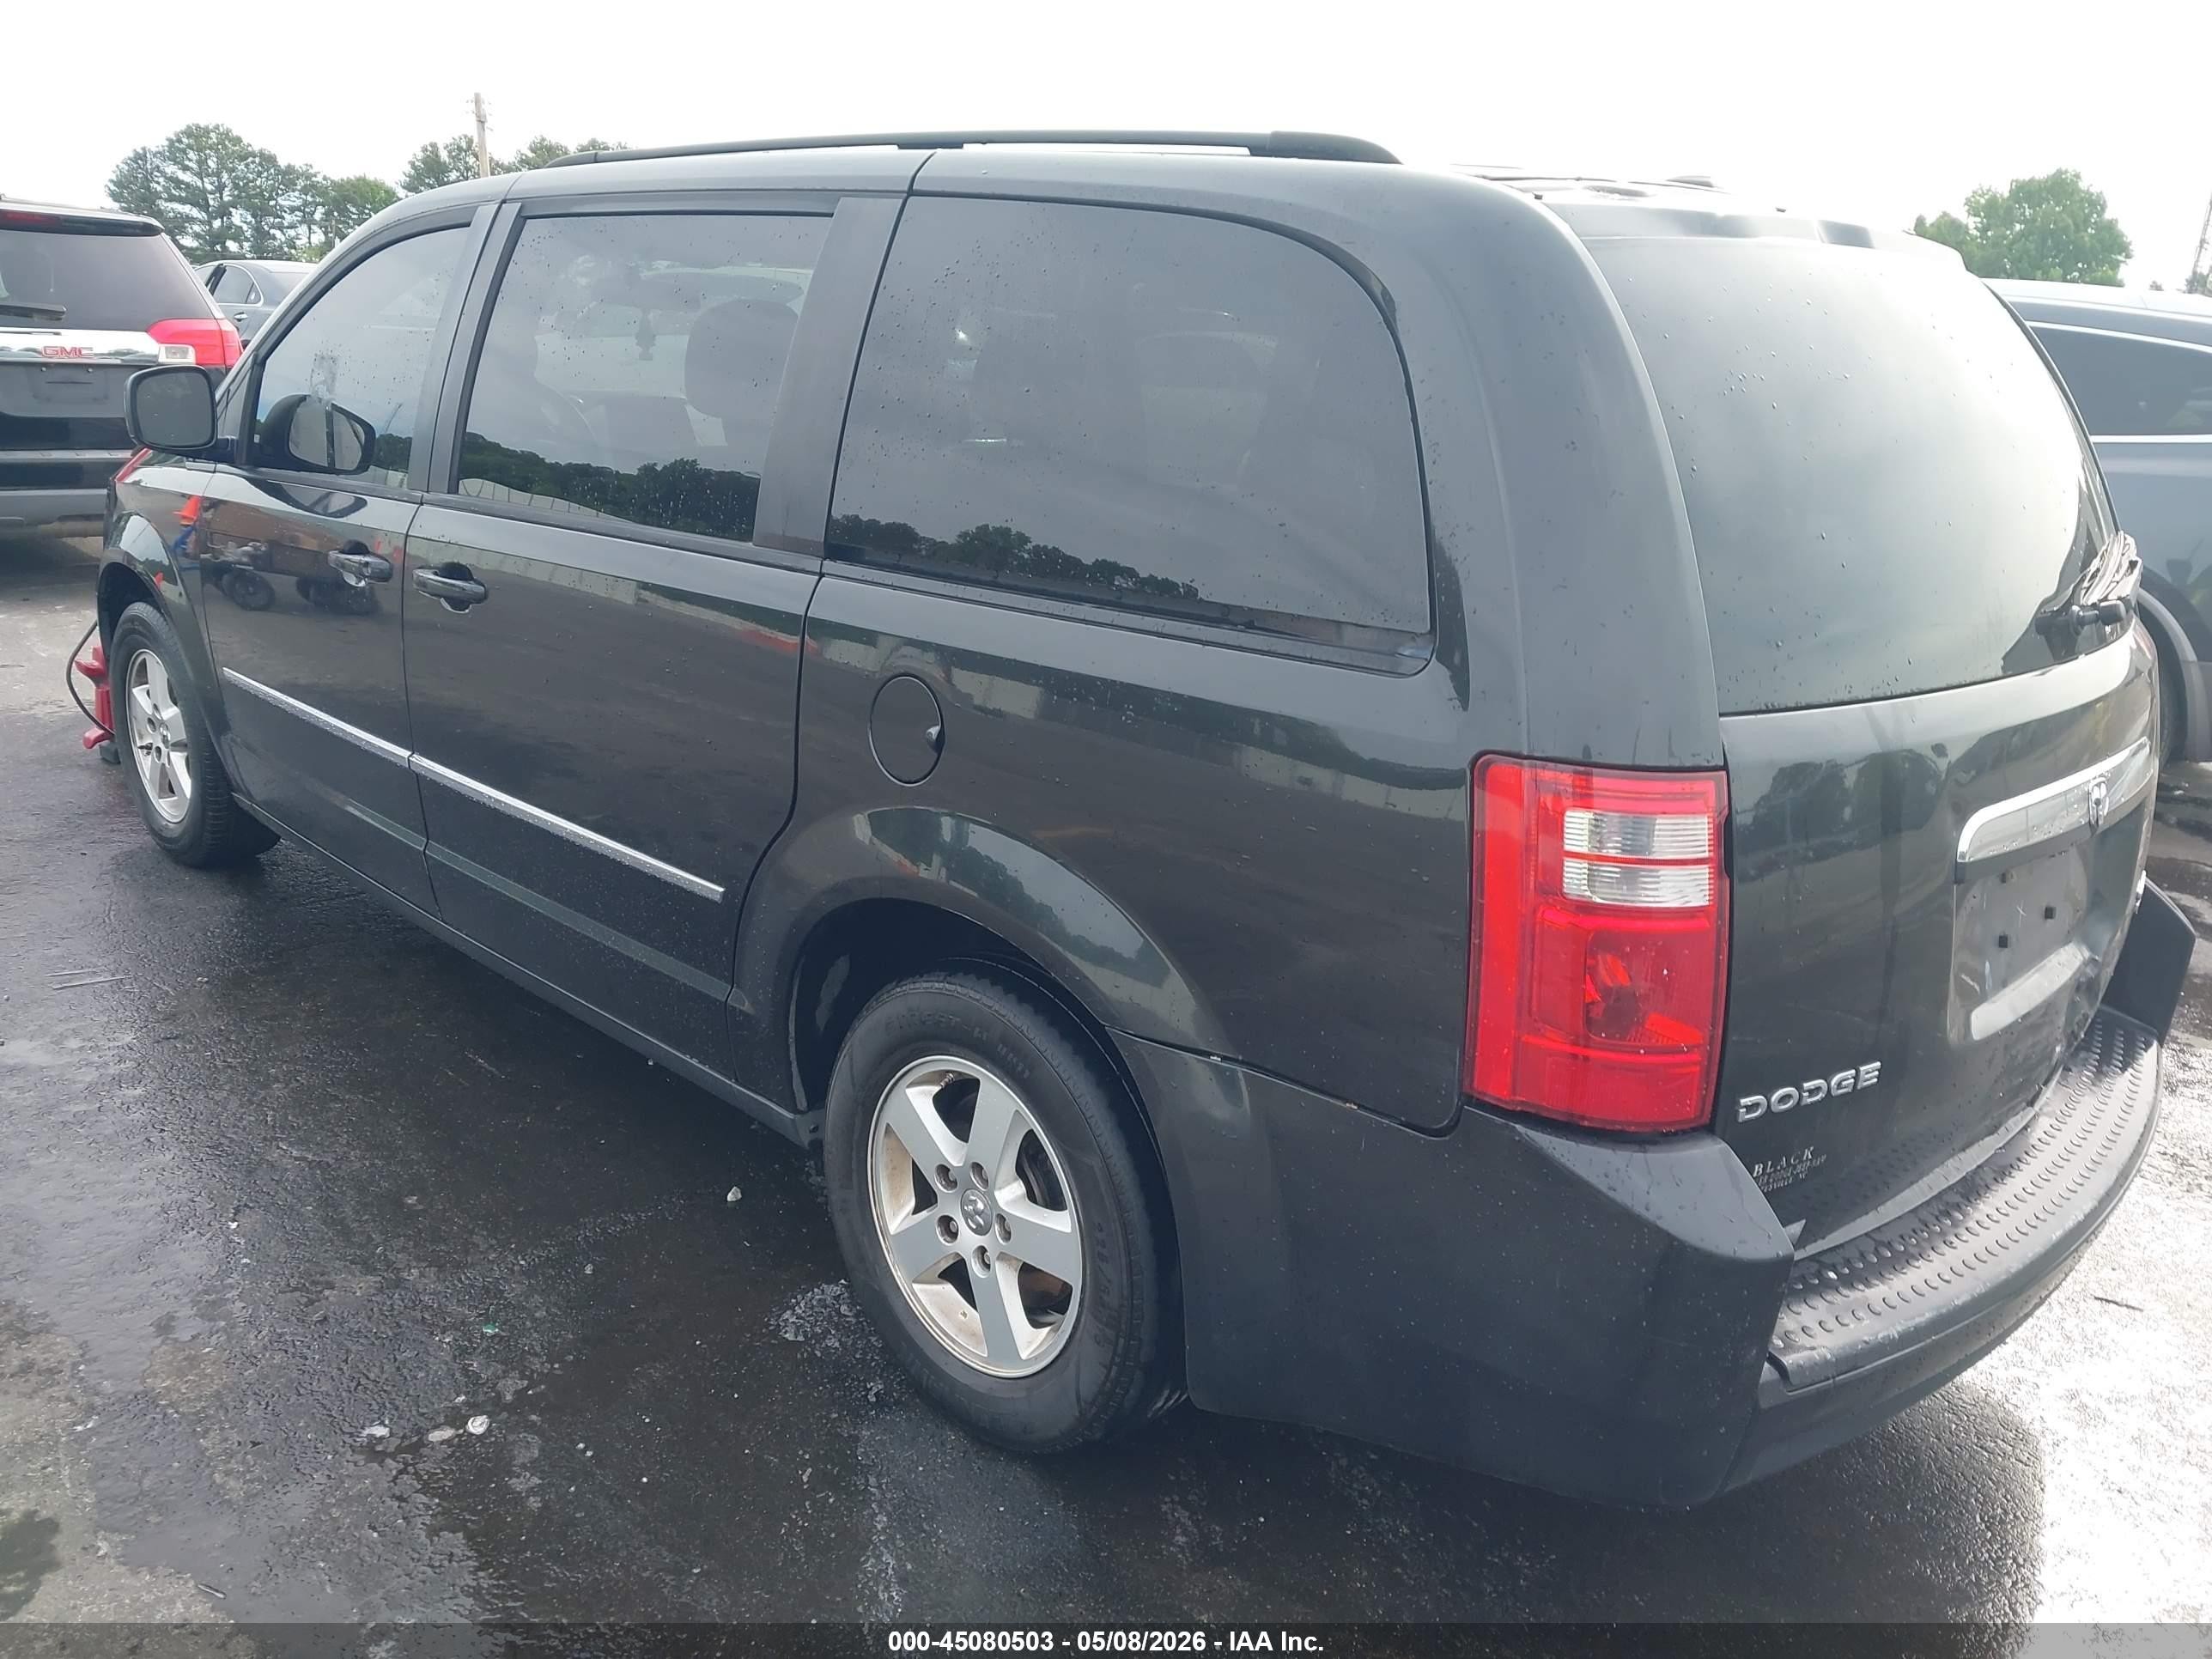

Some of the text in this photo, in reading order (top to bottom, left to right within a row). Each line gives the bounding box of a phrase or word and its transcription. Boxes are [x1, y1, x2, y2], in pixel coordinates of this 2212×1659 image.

[40, 345, 94, 359] GMC
[1737, 1060, 1882, 1123] DODGE
[1753, 1146, 1814, 1177] BLACK
